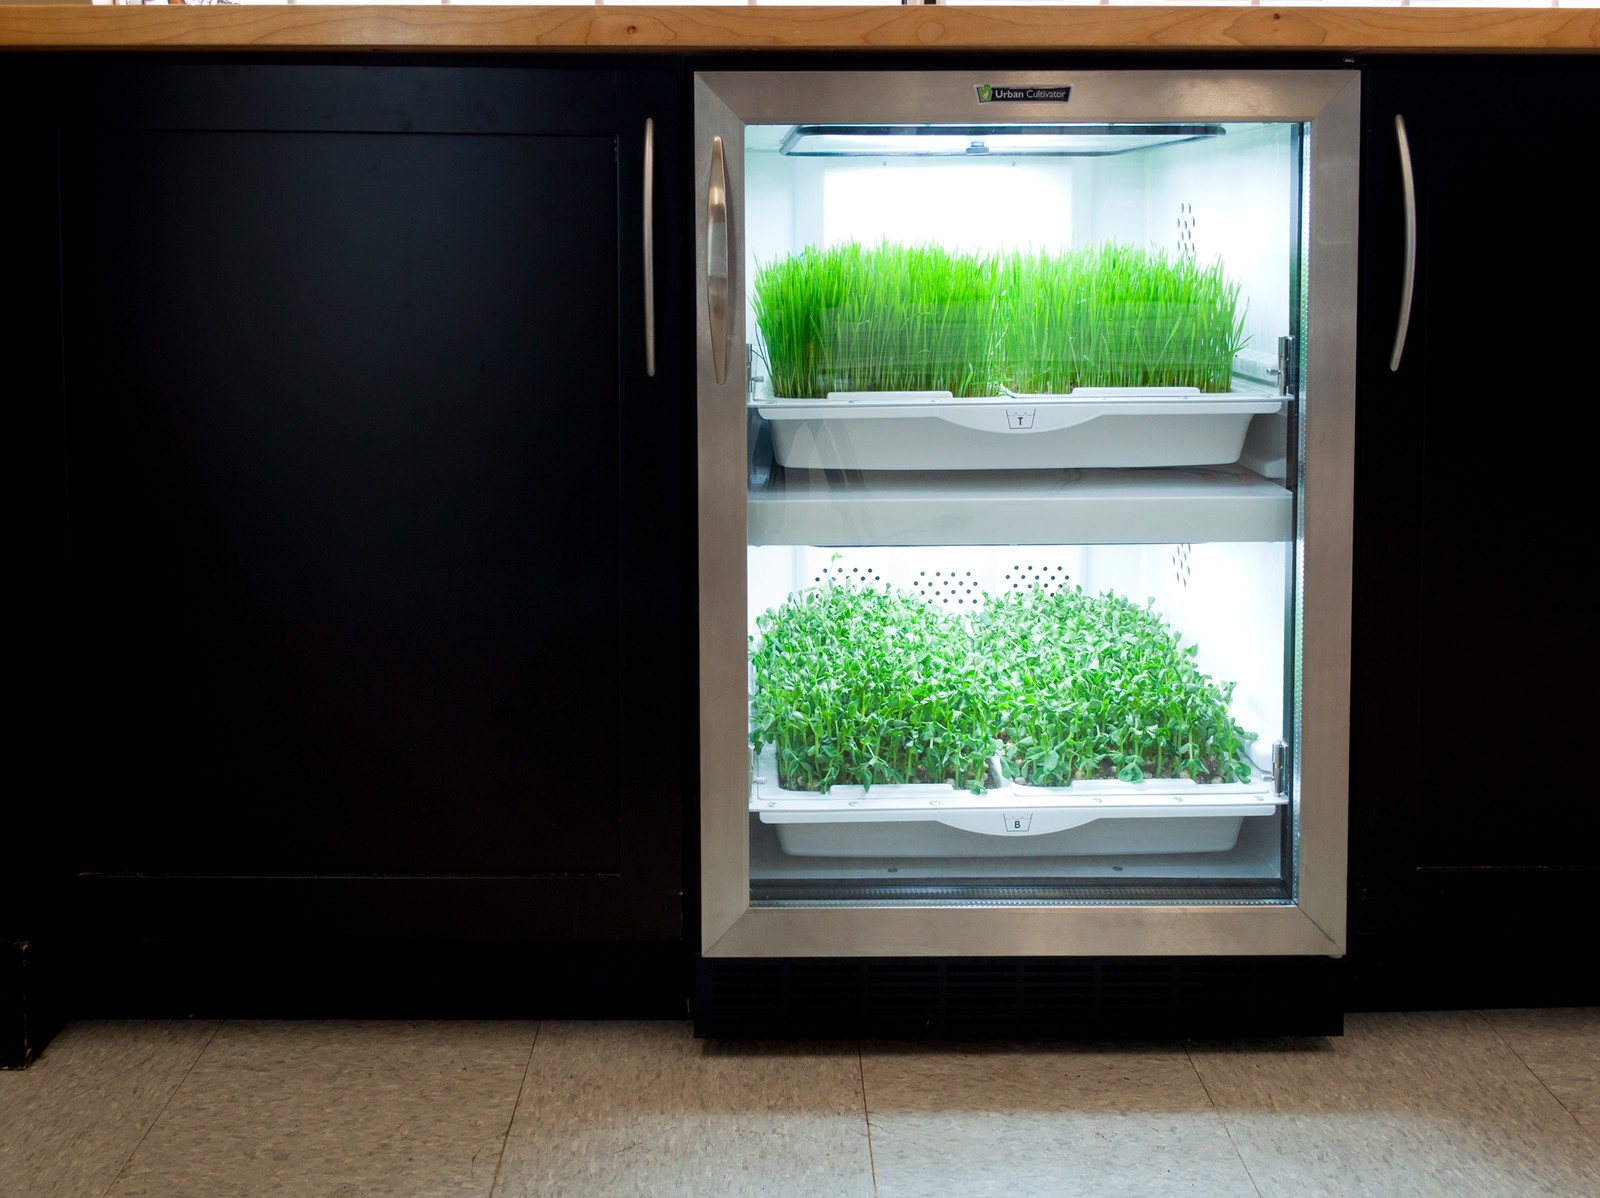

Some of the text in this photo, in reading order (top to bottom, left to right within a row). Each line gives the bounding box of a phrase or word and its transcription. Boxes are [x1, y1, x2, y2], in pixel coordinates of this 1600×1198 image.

[995, 90, 1066, 98] Urban Cultivator
[1017, 416, 1024, 426] T
[1014, 820, 1021, 829] B
